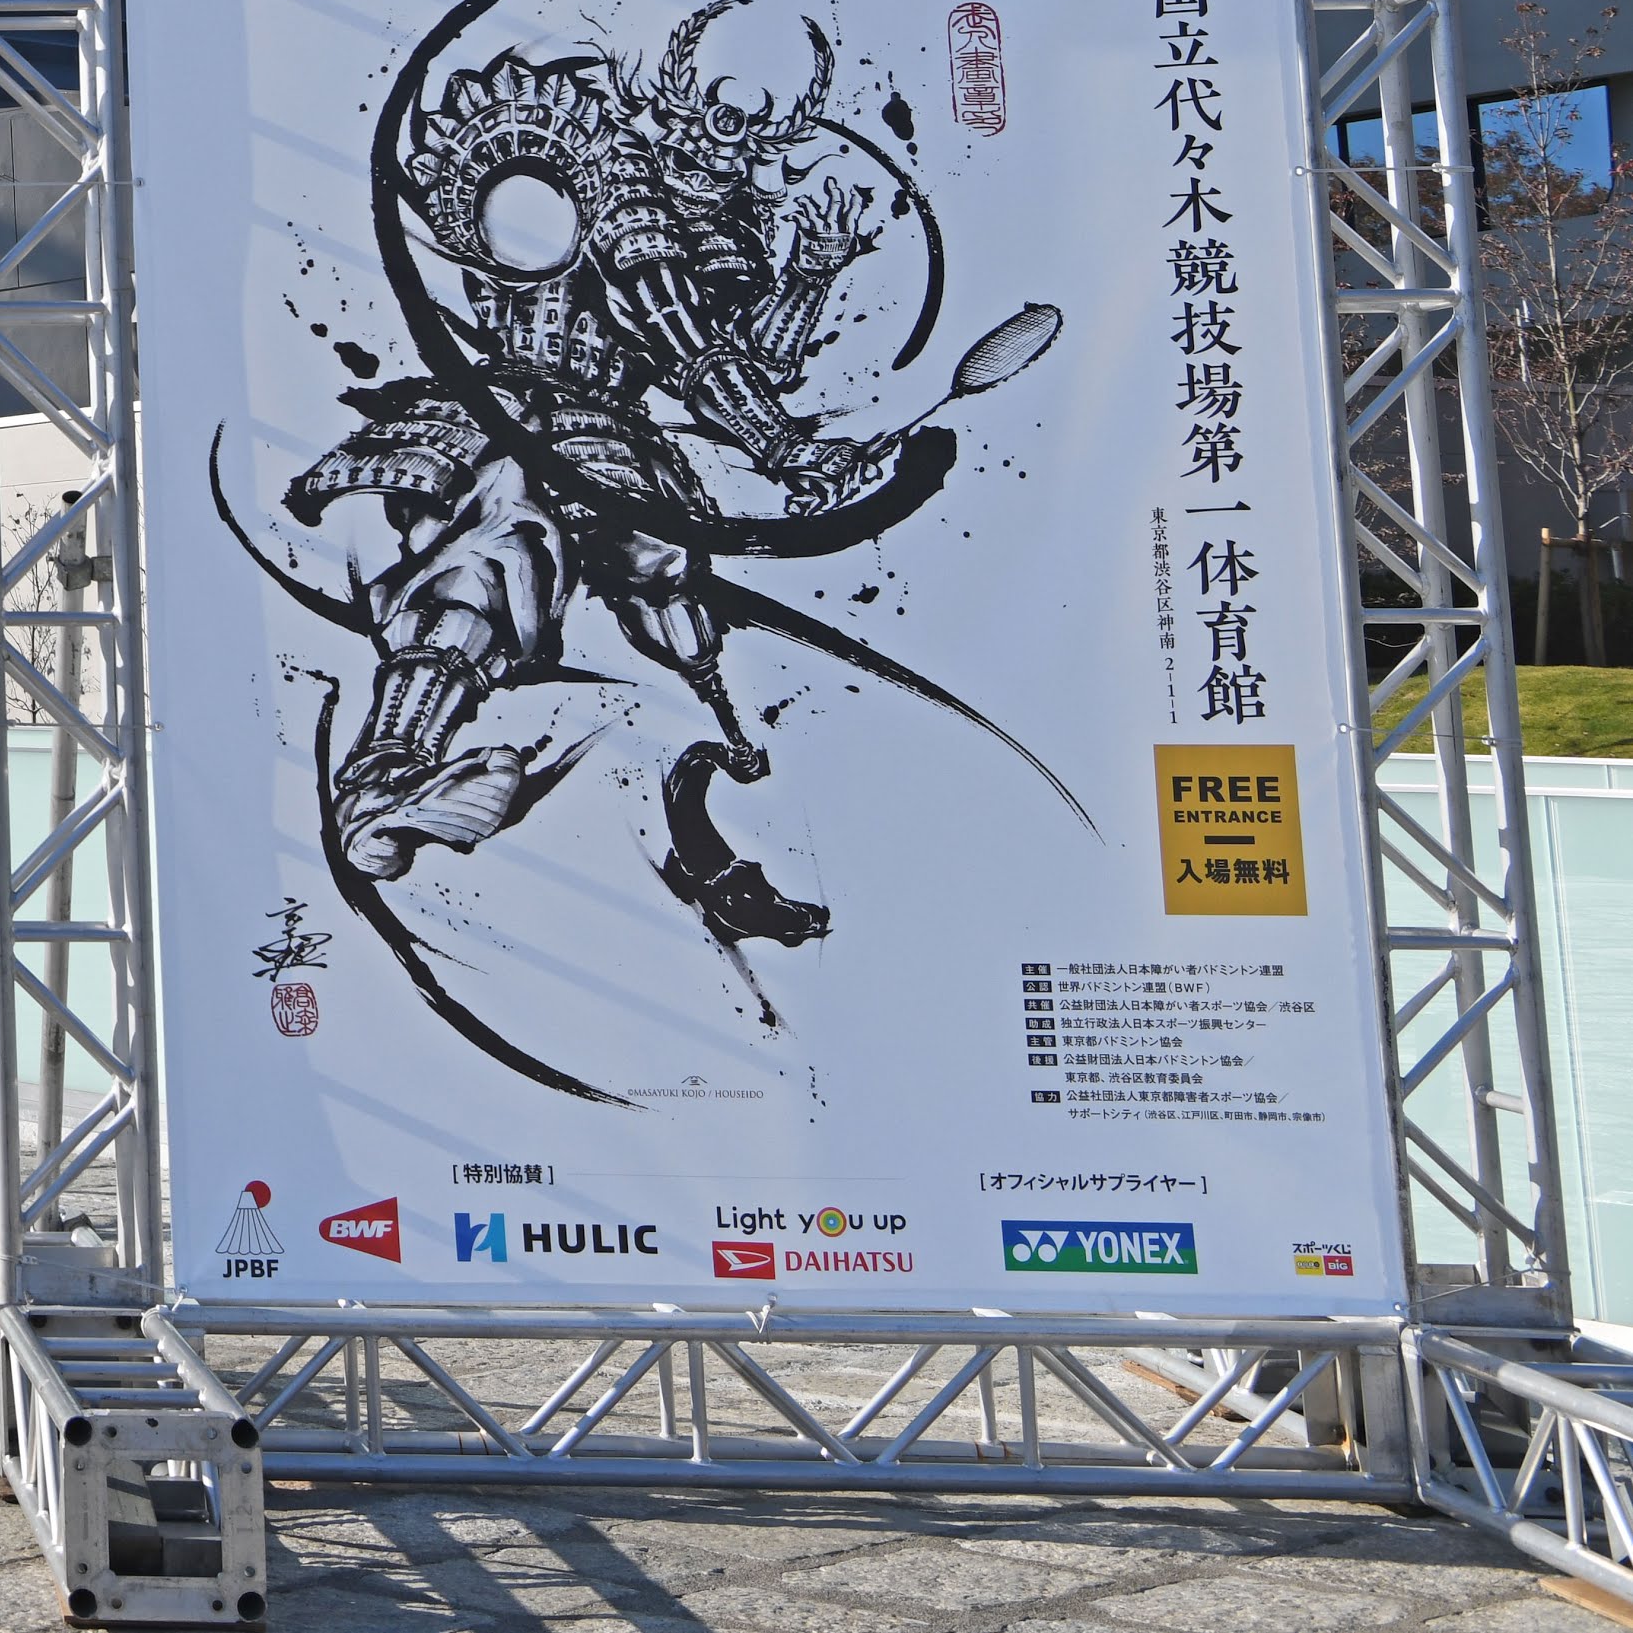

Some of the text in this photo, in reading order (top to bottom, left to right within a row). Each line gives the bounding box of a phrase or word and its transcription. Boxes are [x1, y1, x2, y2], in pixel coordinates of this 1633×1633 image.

[1171, 775, 1281, 803] FREE
[1173, 810, 1283, 825] ENTRANCE
[1176, 857, 1290, 886] 入場無料
[1025, 964, 1050, 975] 主催
[1026, 982, 1049, 992] 公認
[1027, 1000, 1051, 1010] 共催
[1028, 1019, 1052, 1029] 助成
[1029, 1036, 1183, 1048] 主管 東京都バドミントン協会
[1031, 1055, 1055, 1065] 後援
[681, 1089, 706, 1099] KOJO
[715, 1089, 764, 1099] HOUSEIDO
[1034, 1092, 1058, 1102] 協力
[716, 1205, 787, 1235] Light
[873, 1214, 907, 1235] up
[328, 1220, 393, 1239] BWF
[522, 1223, 659, 1255] HULIC
[1080, 1231, 1186, 1266] YONEX
[1292, 1240, 1351, 1255] スポーツくじ
[222, 1258, 279, 1279] JPBF
[784, 1251, 913, 1273] DAIHATSU
